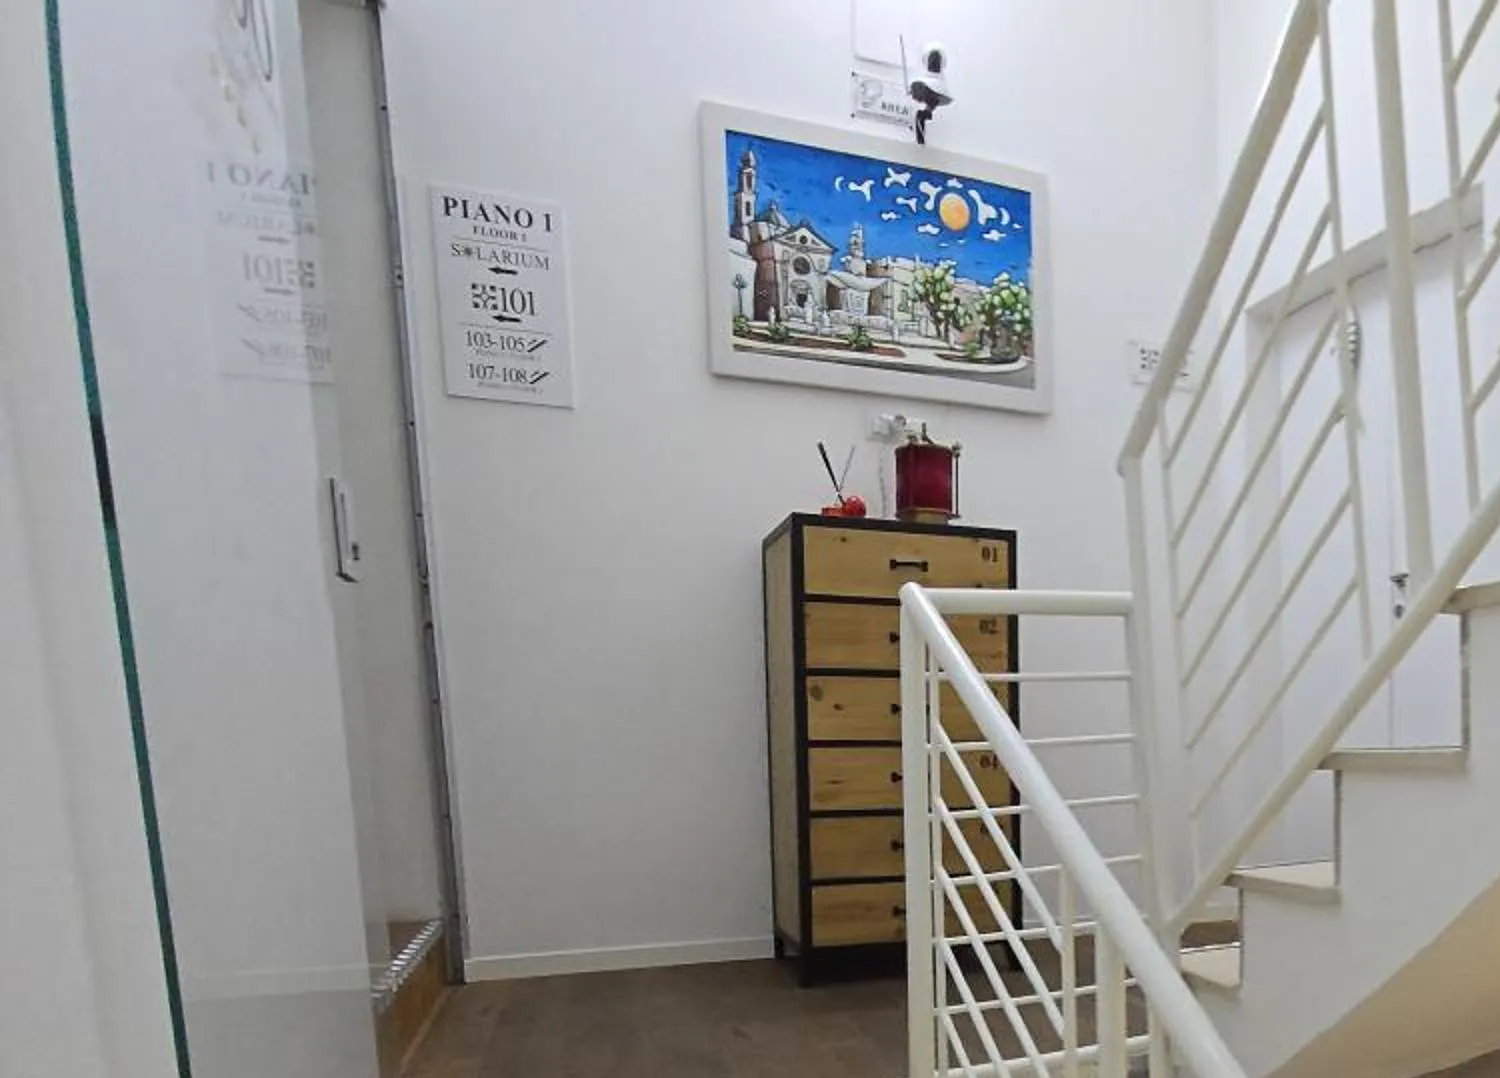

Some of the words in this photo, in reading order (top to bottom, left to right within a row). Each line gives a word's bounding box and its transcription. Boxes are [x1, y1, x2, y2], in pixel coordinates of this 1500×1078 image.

[441, 195, 534, 229] PIANO
[472, 225, 519, 241] FLOOR
[499, 286, 536, 317] 101
[466, 329, 526, 353] 103-105
[468, 362, 529, 385] 107-108
[980, 546, 998, 563] 01
